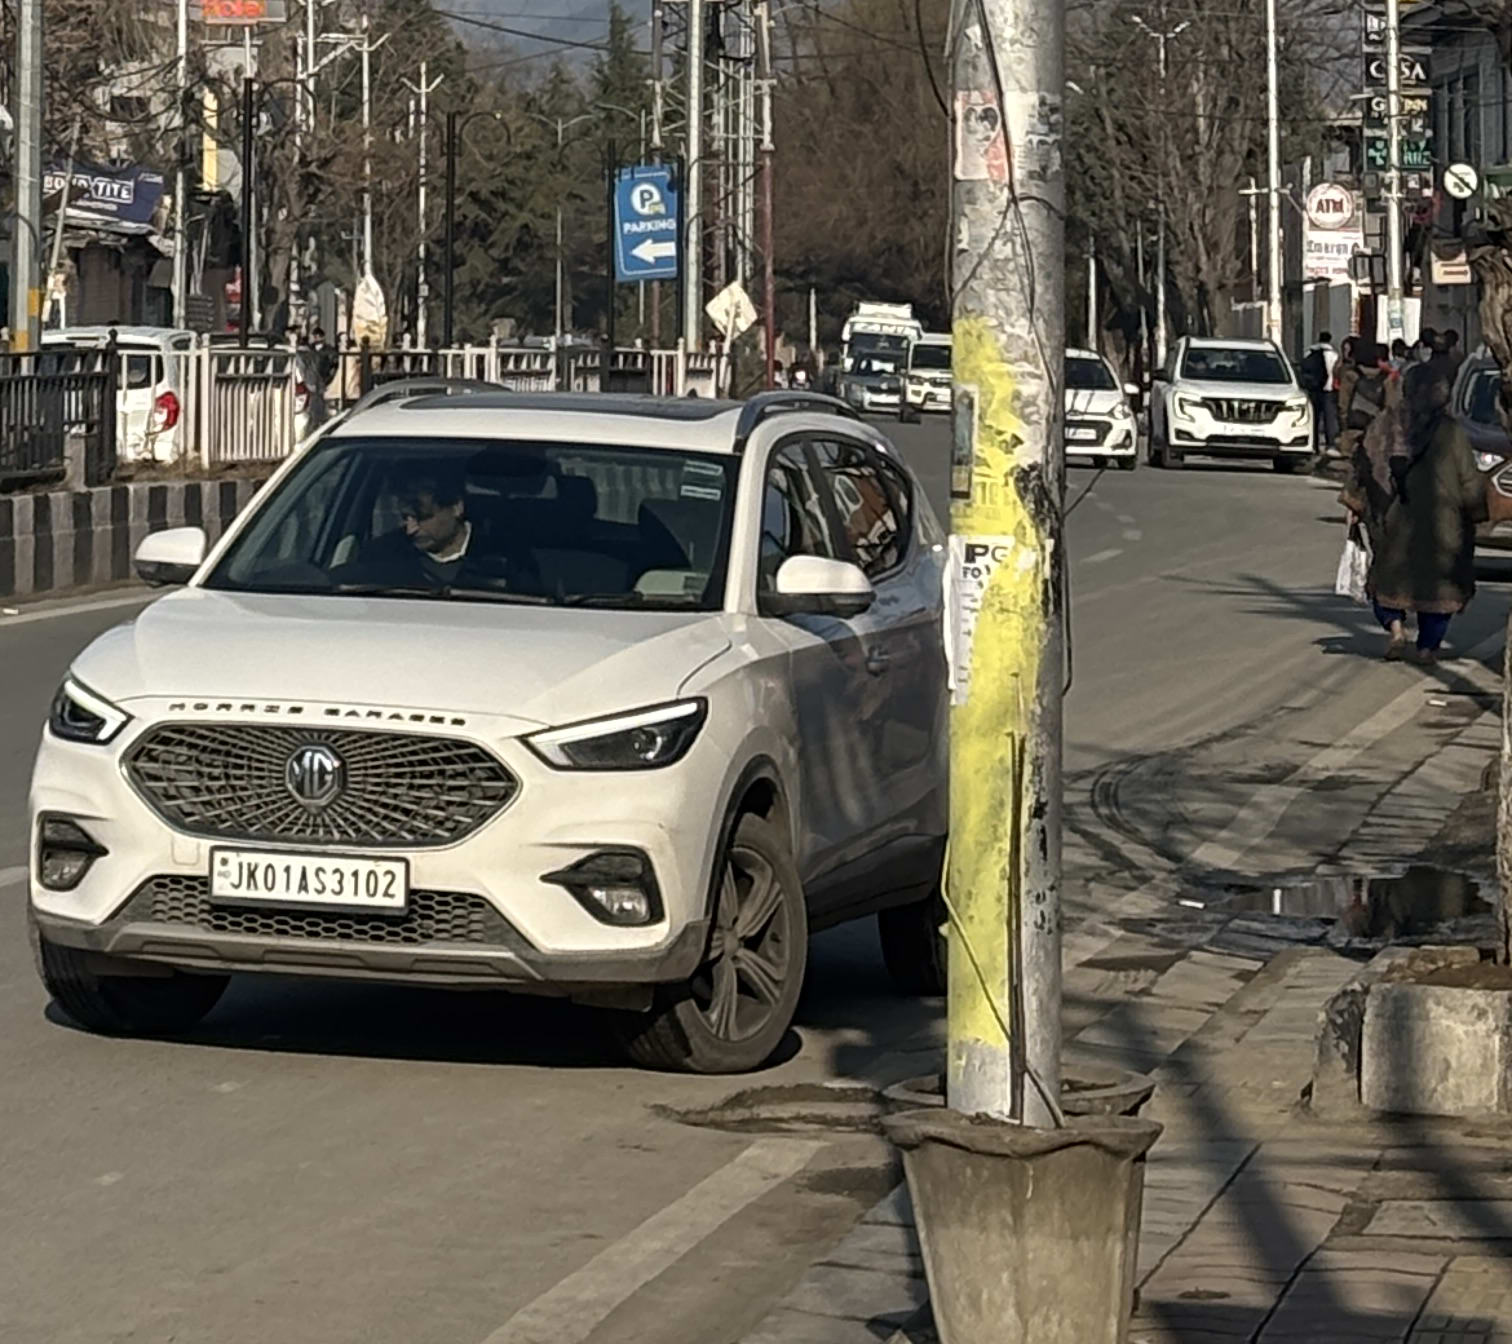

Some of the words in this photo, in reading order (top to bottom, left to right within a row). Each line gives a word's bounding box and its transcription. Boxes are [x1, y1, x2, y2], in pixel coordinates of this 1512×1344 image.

[1369, 60, 1427, 80] CSA
[97, 181, 130, 199] TITE
[639, 189, 654, 210] P
[1316, 198, 1345, 214] ATM
[622, 218, 676, 234] PARKING
[168, 701, 304, 715] MORRIS
[324, 707, 467, 727] GARAGES
[291, 749, 335, 800] MG
[229, 860, 397, 900] JK01AS3102
